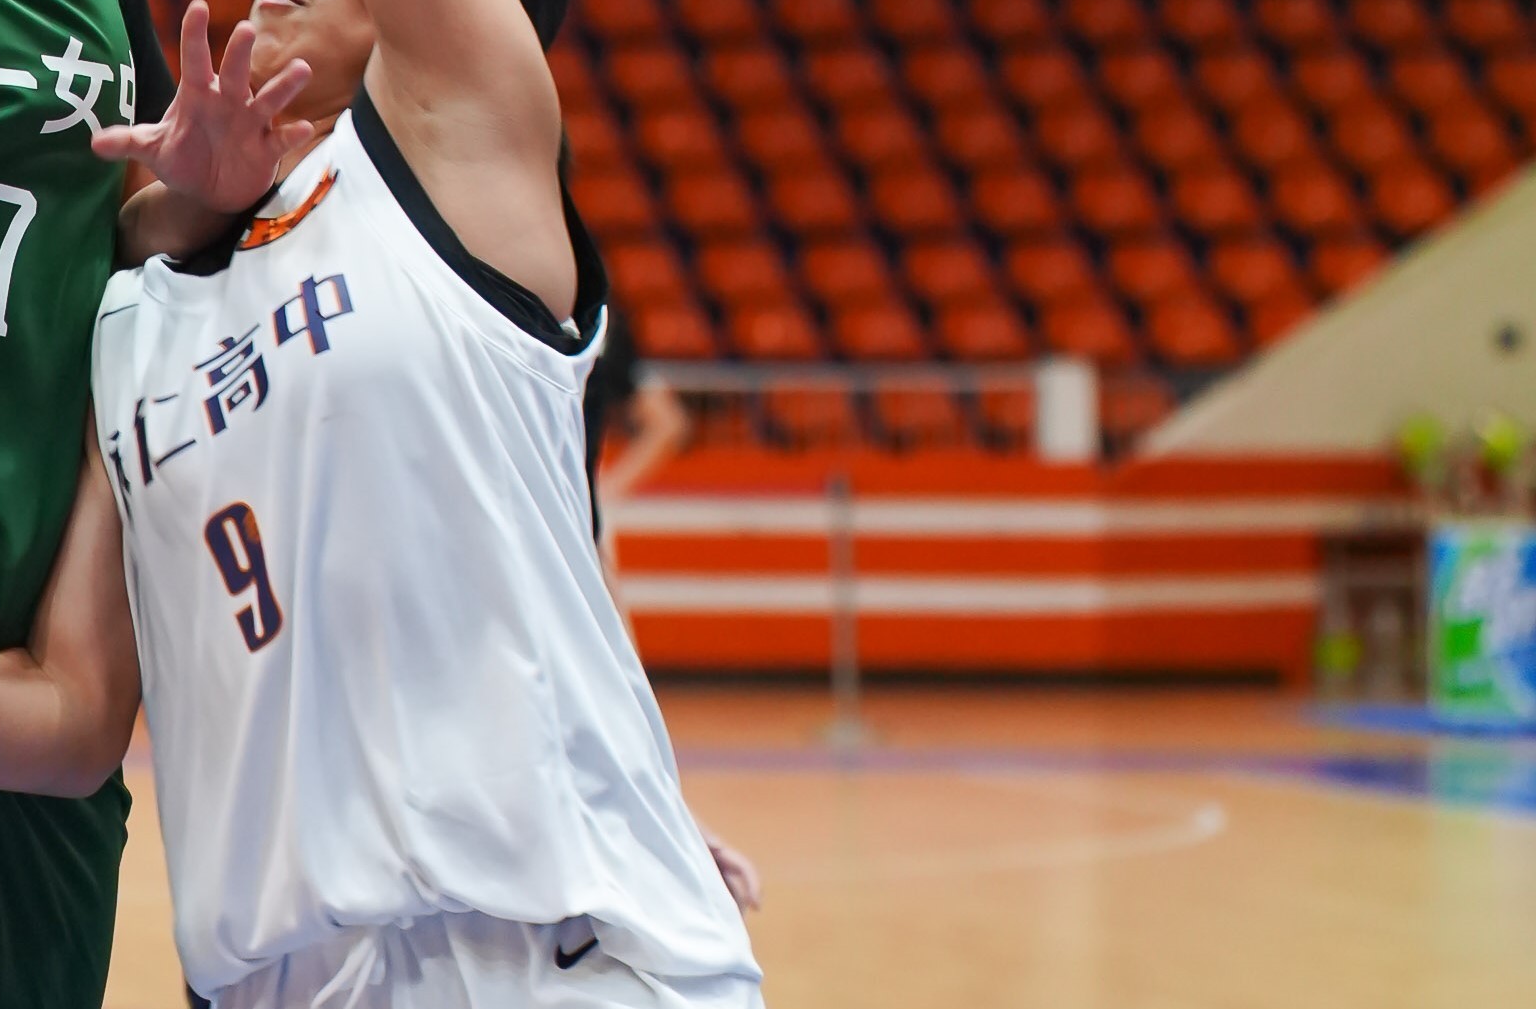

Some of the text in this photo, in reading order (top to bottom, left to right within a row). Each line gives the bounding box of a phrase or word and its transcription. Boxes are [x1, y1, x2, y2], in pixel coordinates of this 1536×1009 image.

[109, 273, 356, 522] 仁高中
[204, 501, 284, 654] 9
